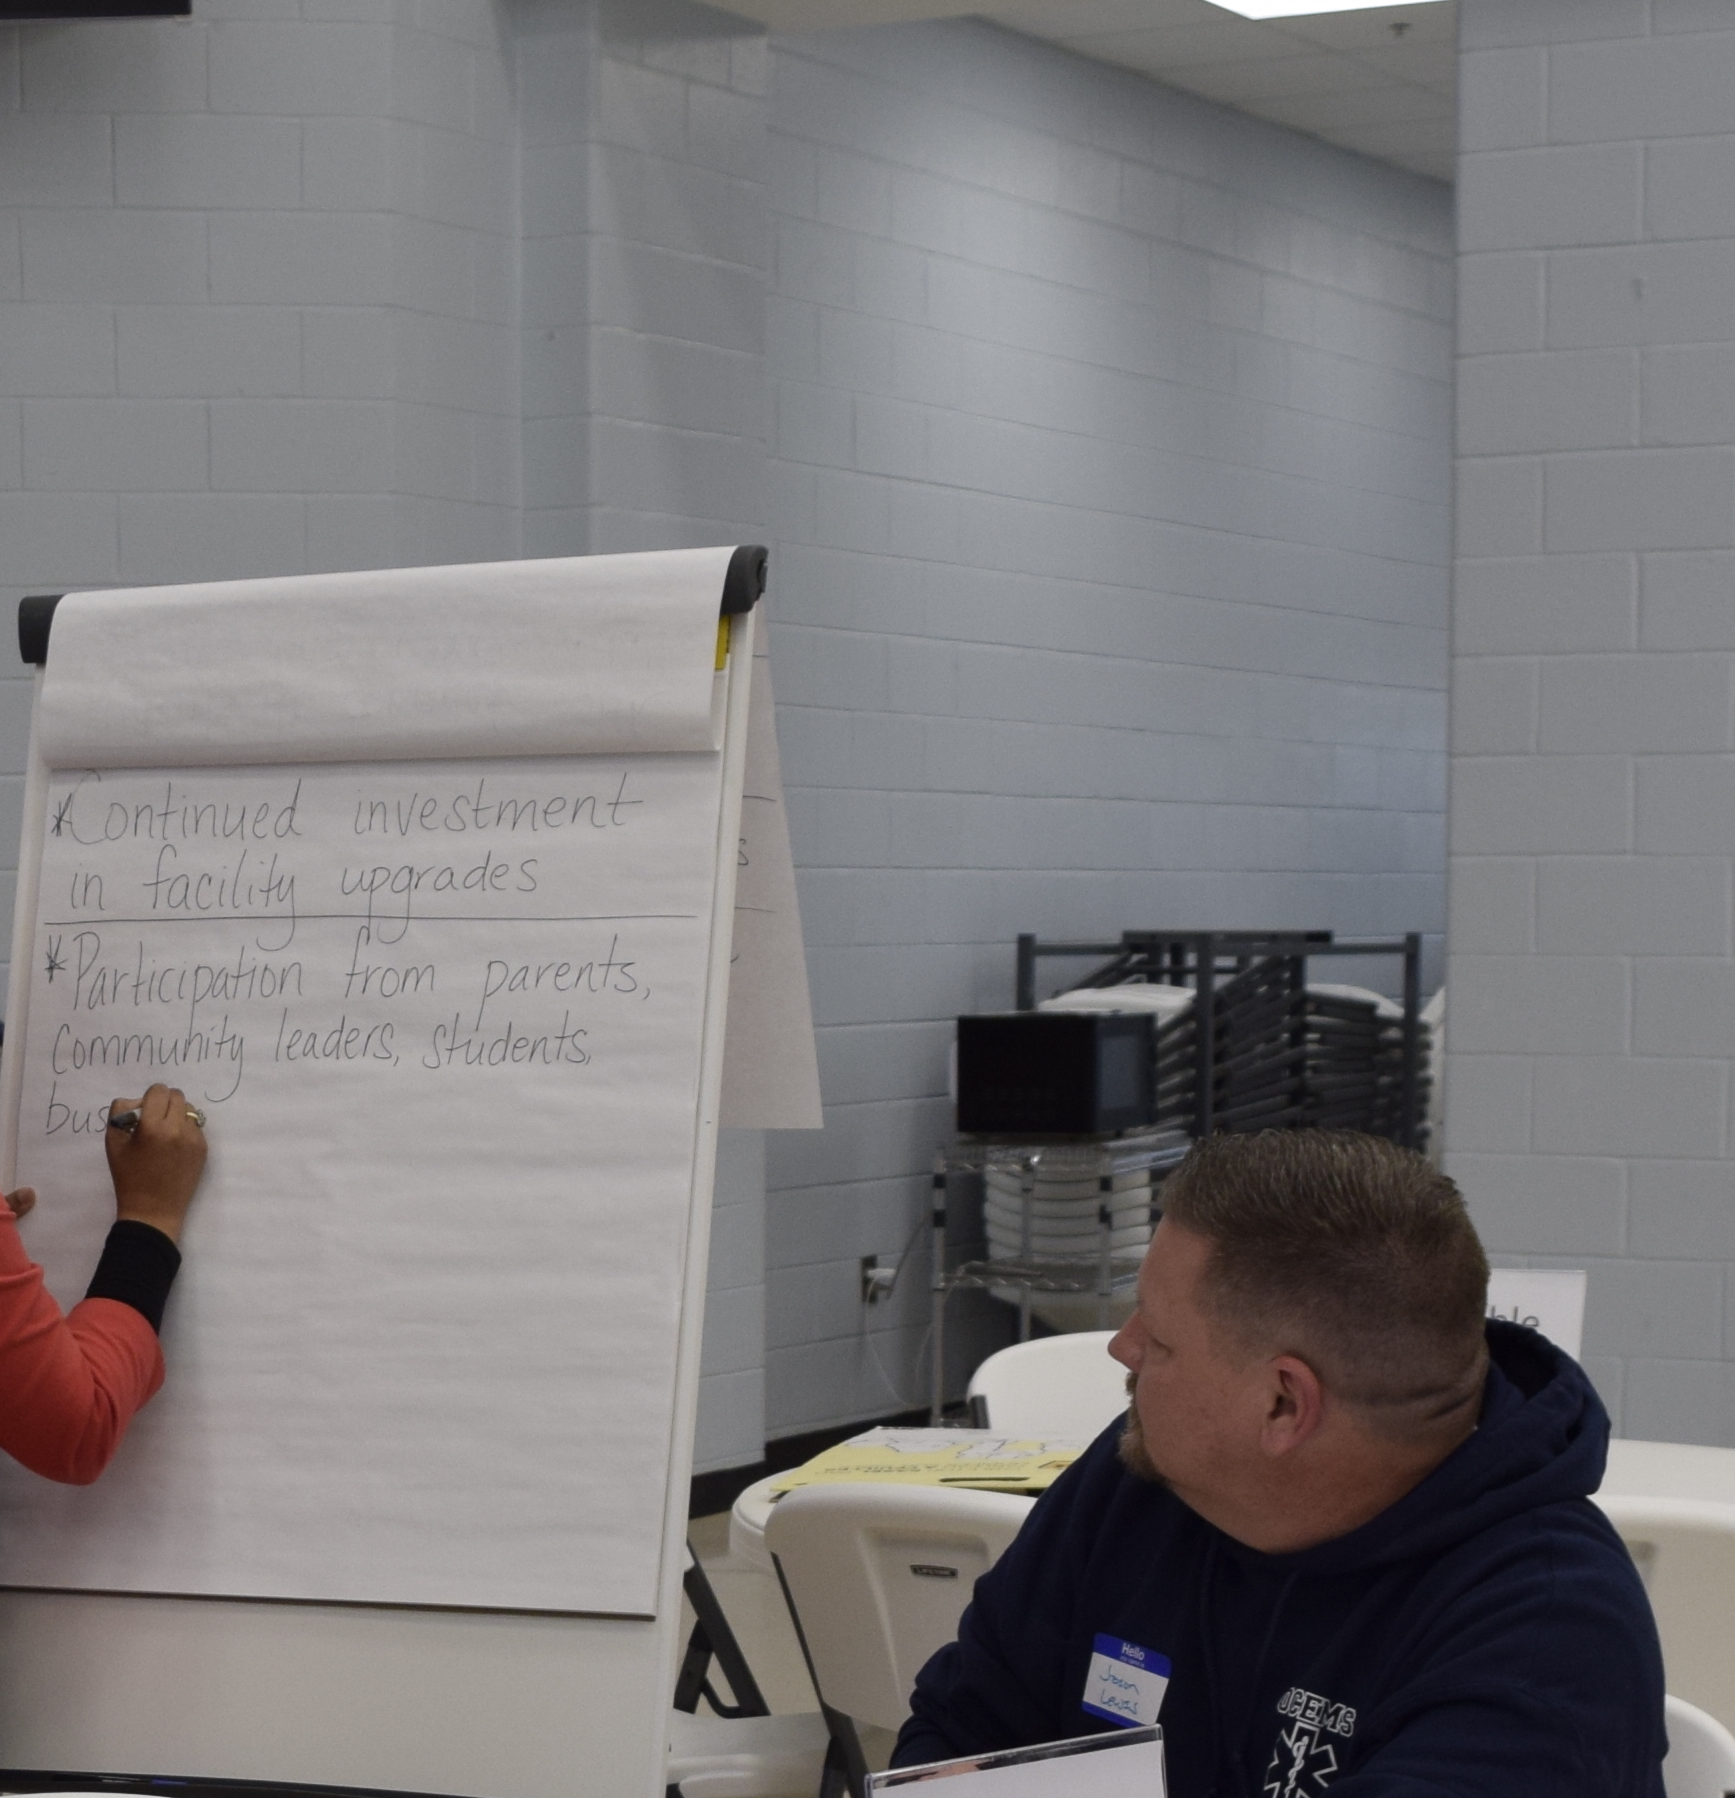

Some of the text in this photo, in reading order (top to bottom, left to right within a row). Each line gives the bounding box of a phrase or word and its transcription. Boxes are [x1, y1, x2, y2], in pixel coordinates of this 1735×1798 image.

[69, 768, 643, 844] Continued investment
[71, 844, 538, 951] in facility upgrades
[72, 925, 651, 1040] Participation from parents,
[275, 1007, 400, 1067] leaders,
[1121, 1642, 1145, 1661] Hello
